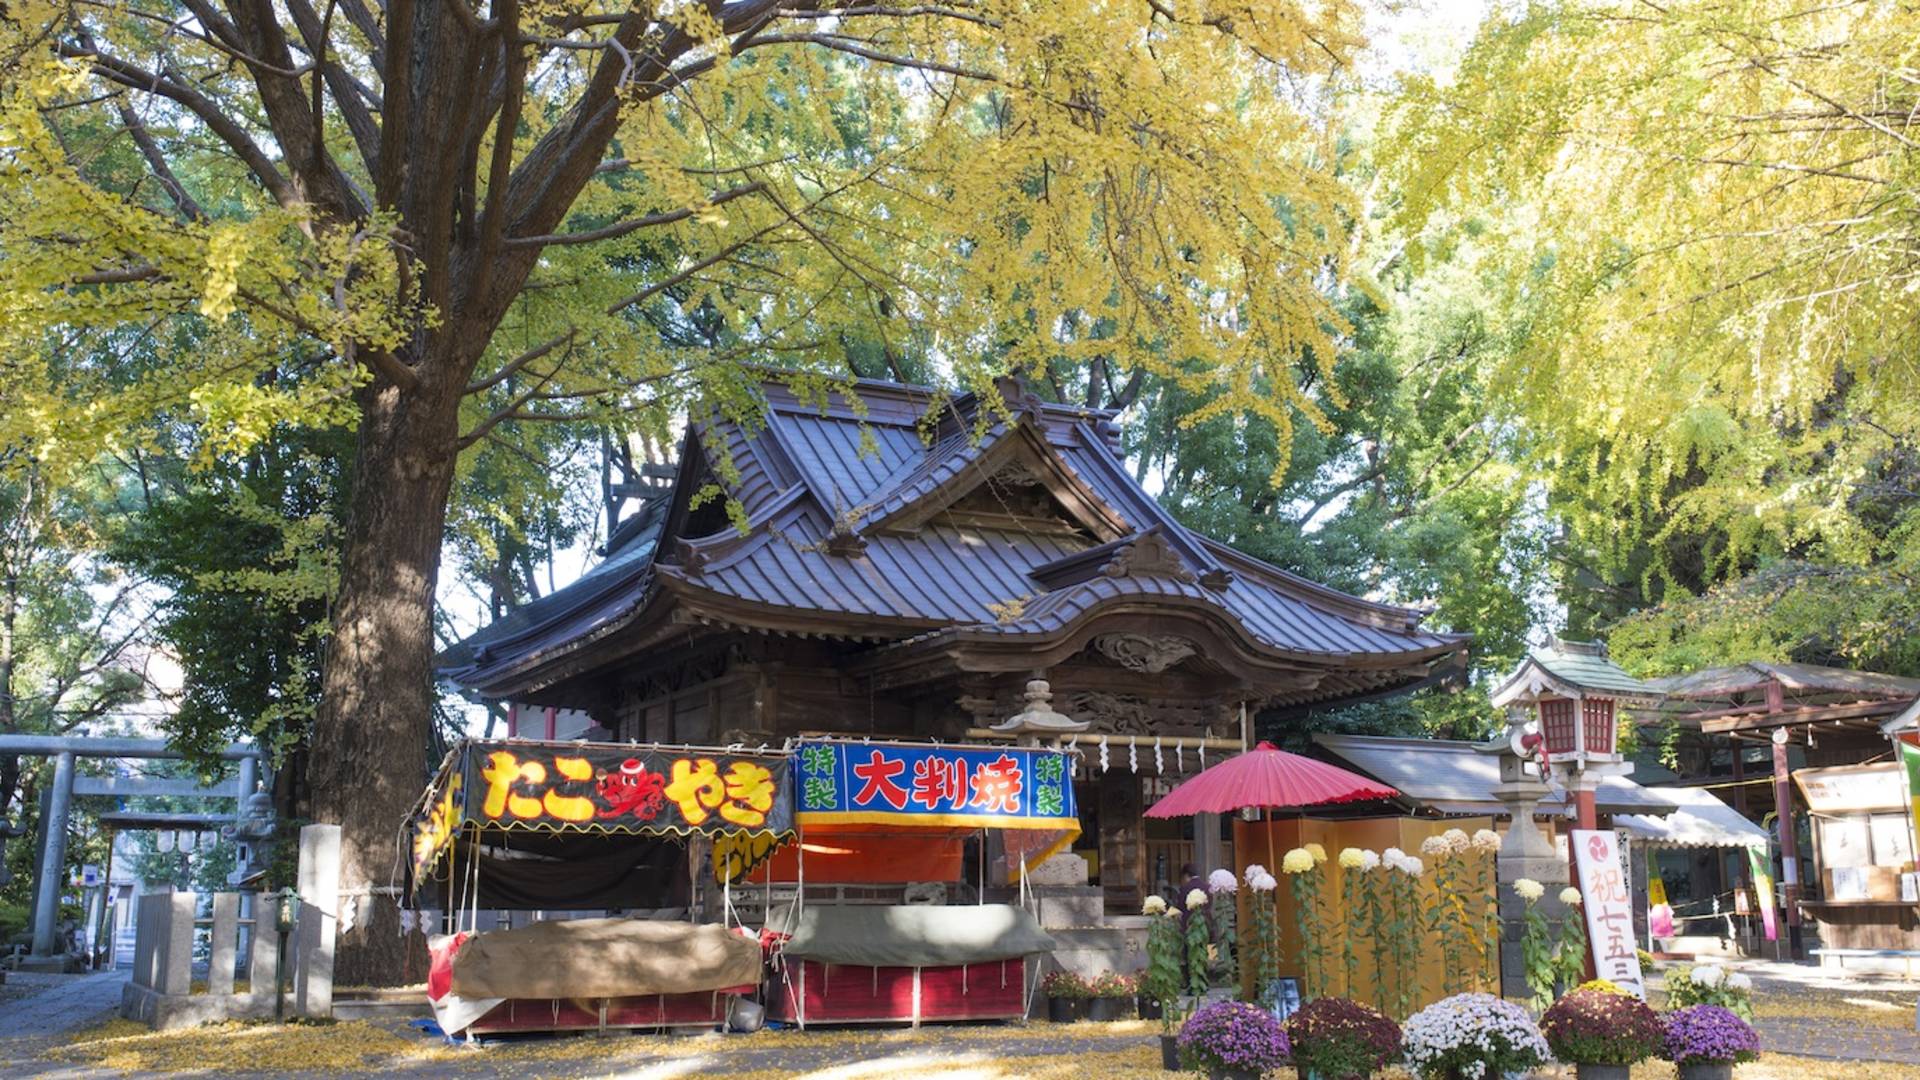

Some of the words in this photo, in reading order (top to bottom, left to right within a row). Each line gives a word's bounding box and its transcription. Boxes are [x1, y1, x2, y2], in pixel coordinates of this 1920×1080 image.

[482, 750, 596, 821] たこ
[664, 758, 776, 826] やき
[802, 744, 837, 809] 特製
[853, 750, 1023, 812] 大判焼
[1035, 754, 1064, 815] 特製
